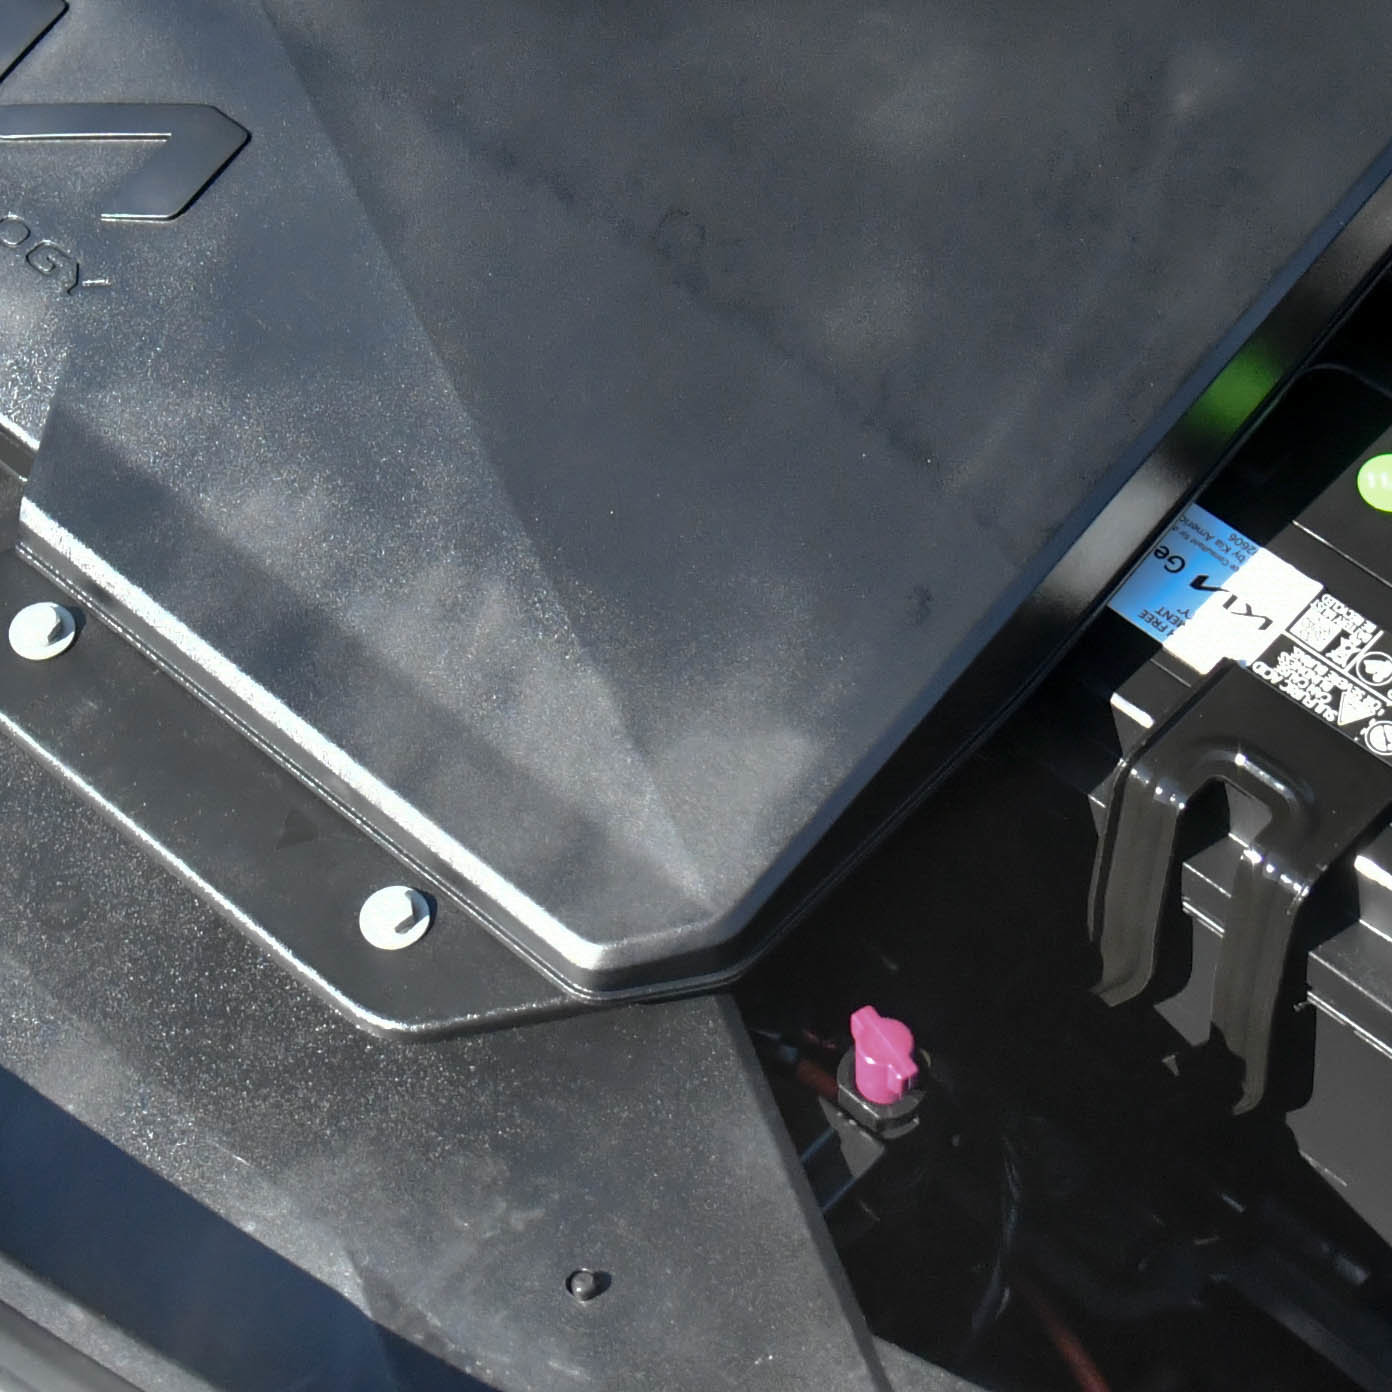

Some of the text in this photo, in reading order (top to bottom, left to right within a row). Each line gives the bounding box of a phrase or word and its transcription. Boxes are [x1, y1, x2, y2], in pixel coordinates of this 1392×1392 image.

[1213, 538, 1232, 554] Kia
[1148, 543, 1274, 634] KIA Ge
[1136, 608, 1168, 633] FREE
[1250, 658, 1339, 723] SULFURIC ACID
